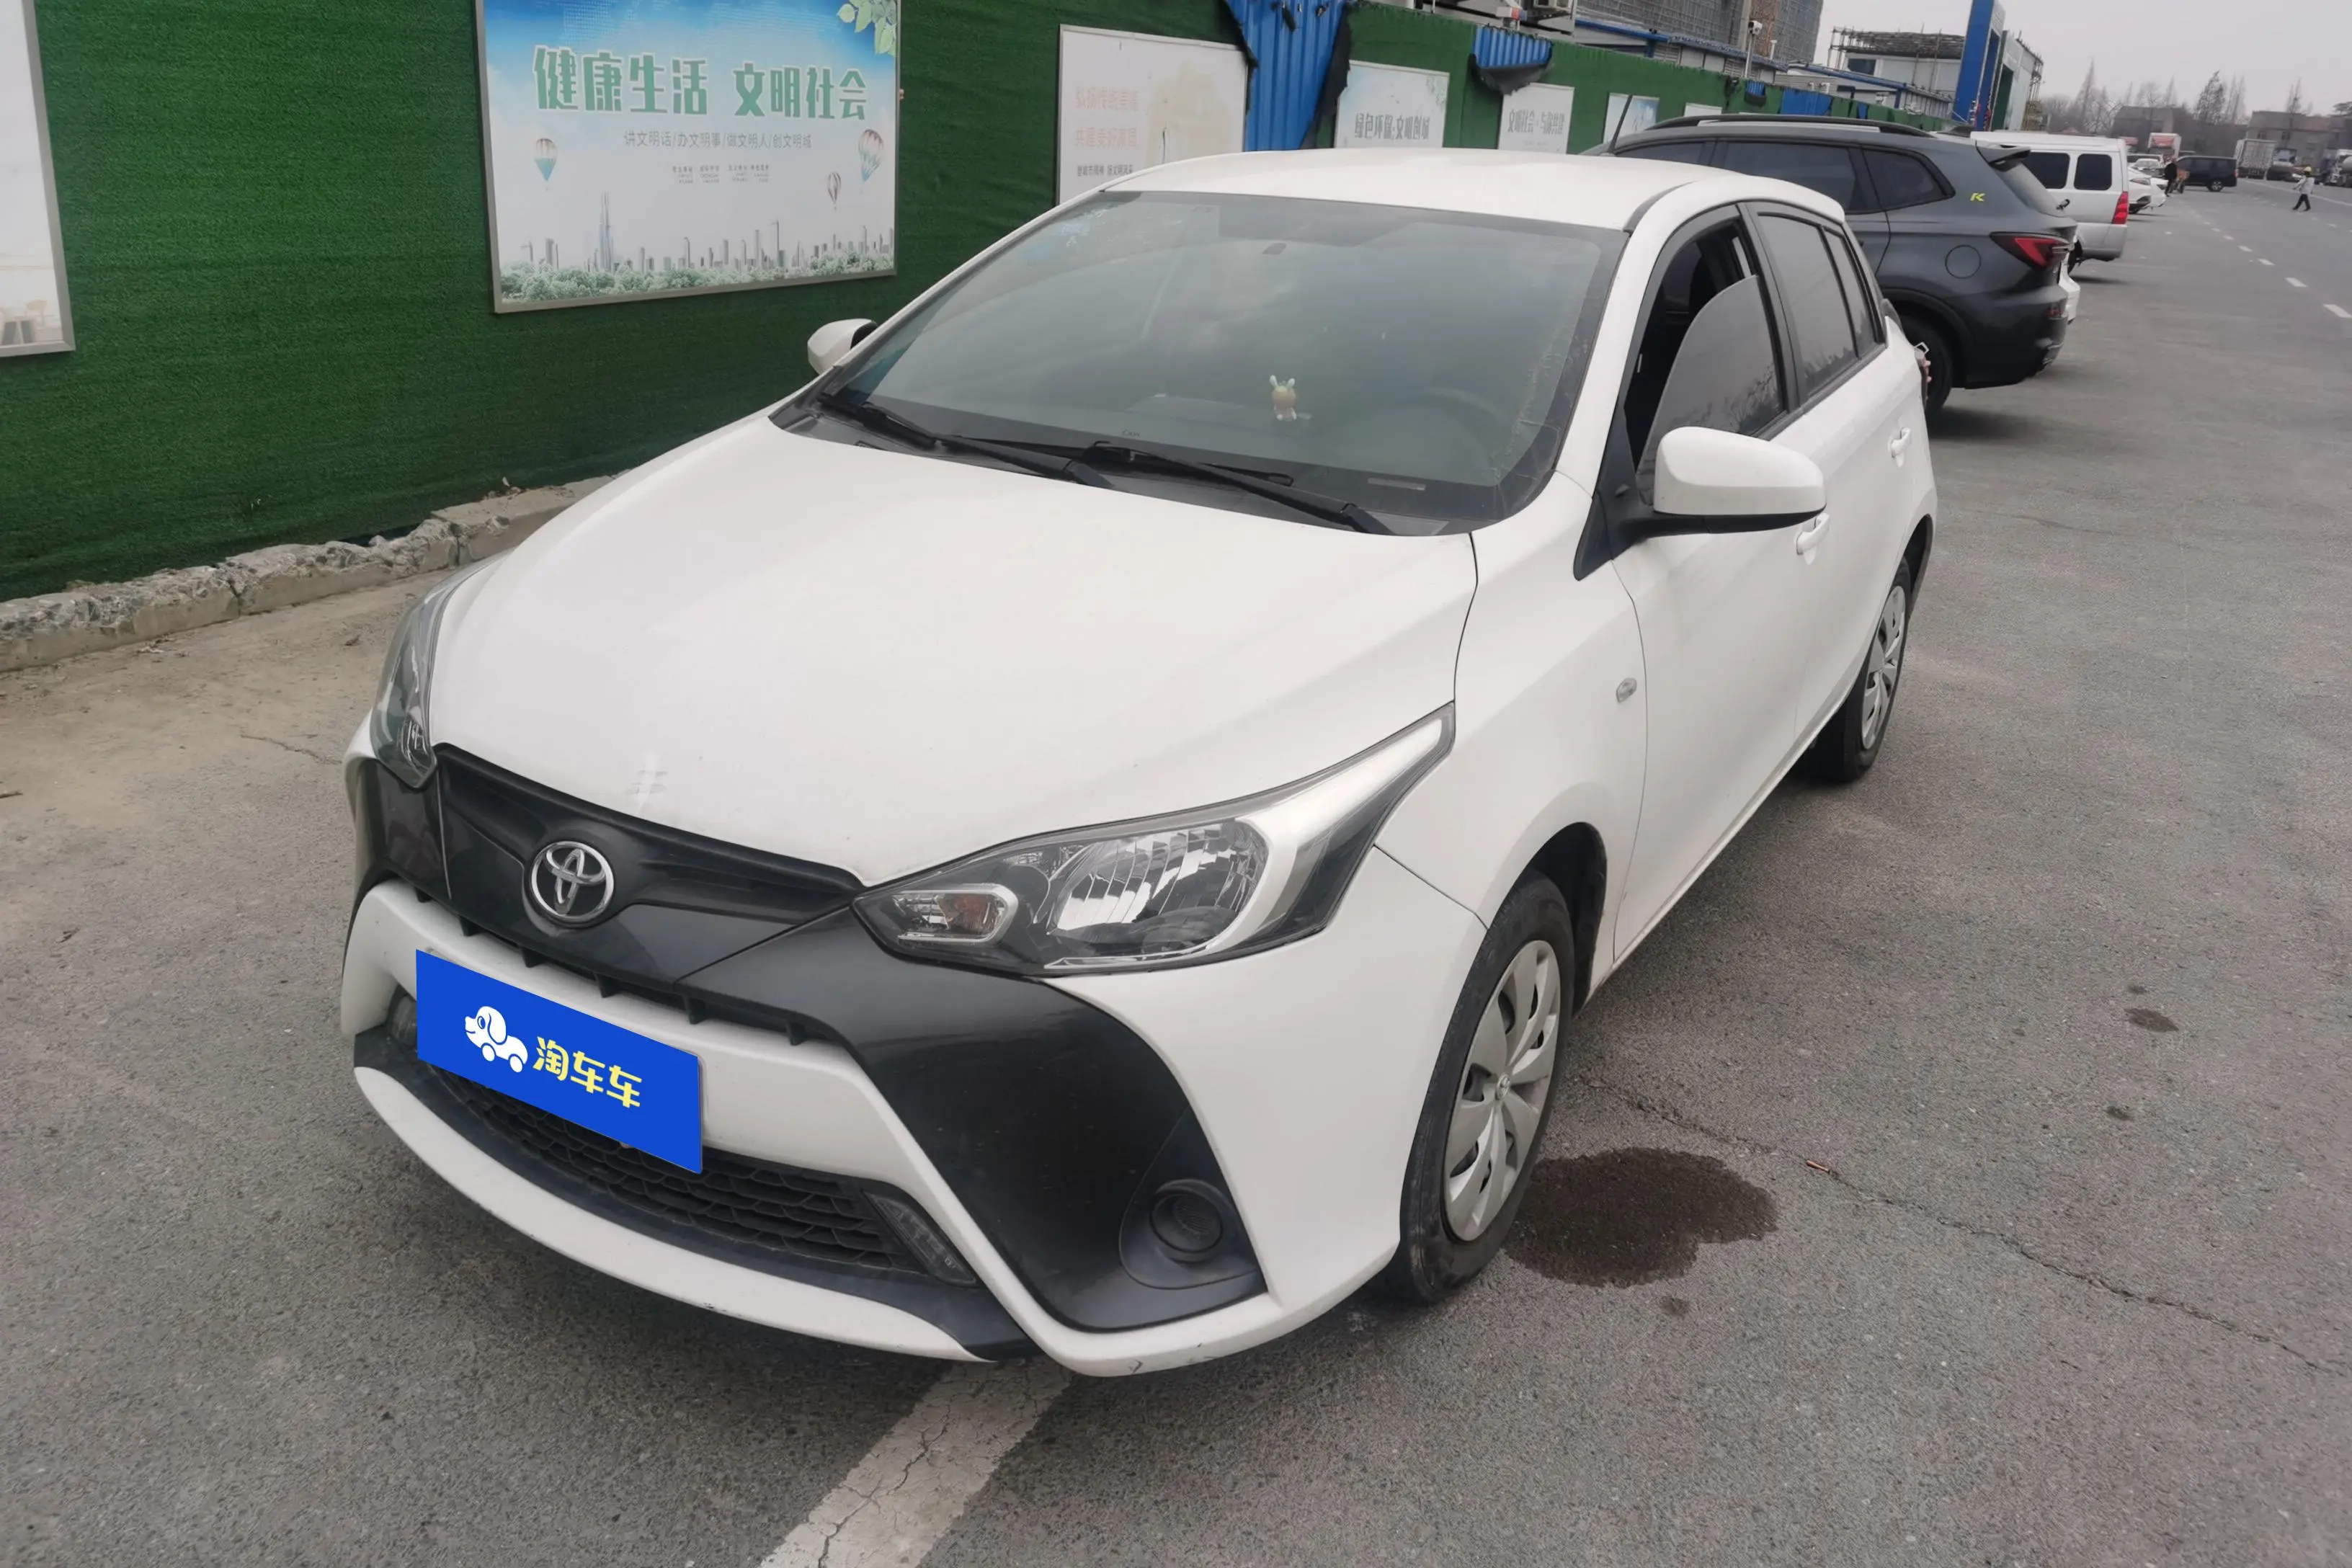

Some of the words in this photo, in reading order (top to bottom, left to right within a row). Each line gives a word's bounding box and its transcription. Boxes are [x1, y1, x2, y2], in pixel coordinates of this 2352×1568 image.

[533, 45, 709, 117] 健康生活
[732, 62, 868, 121] 文明社会
